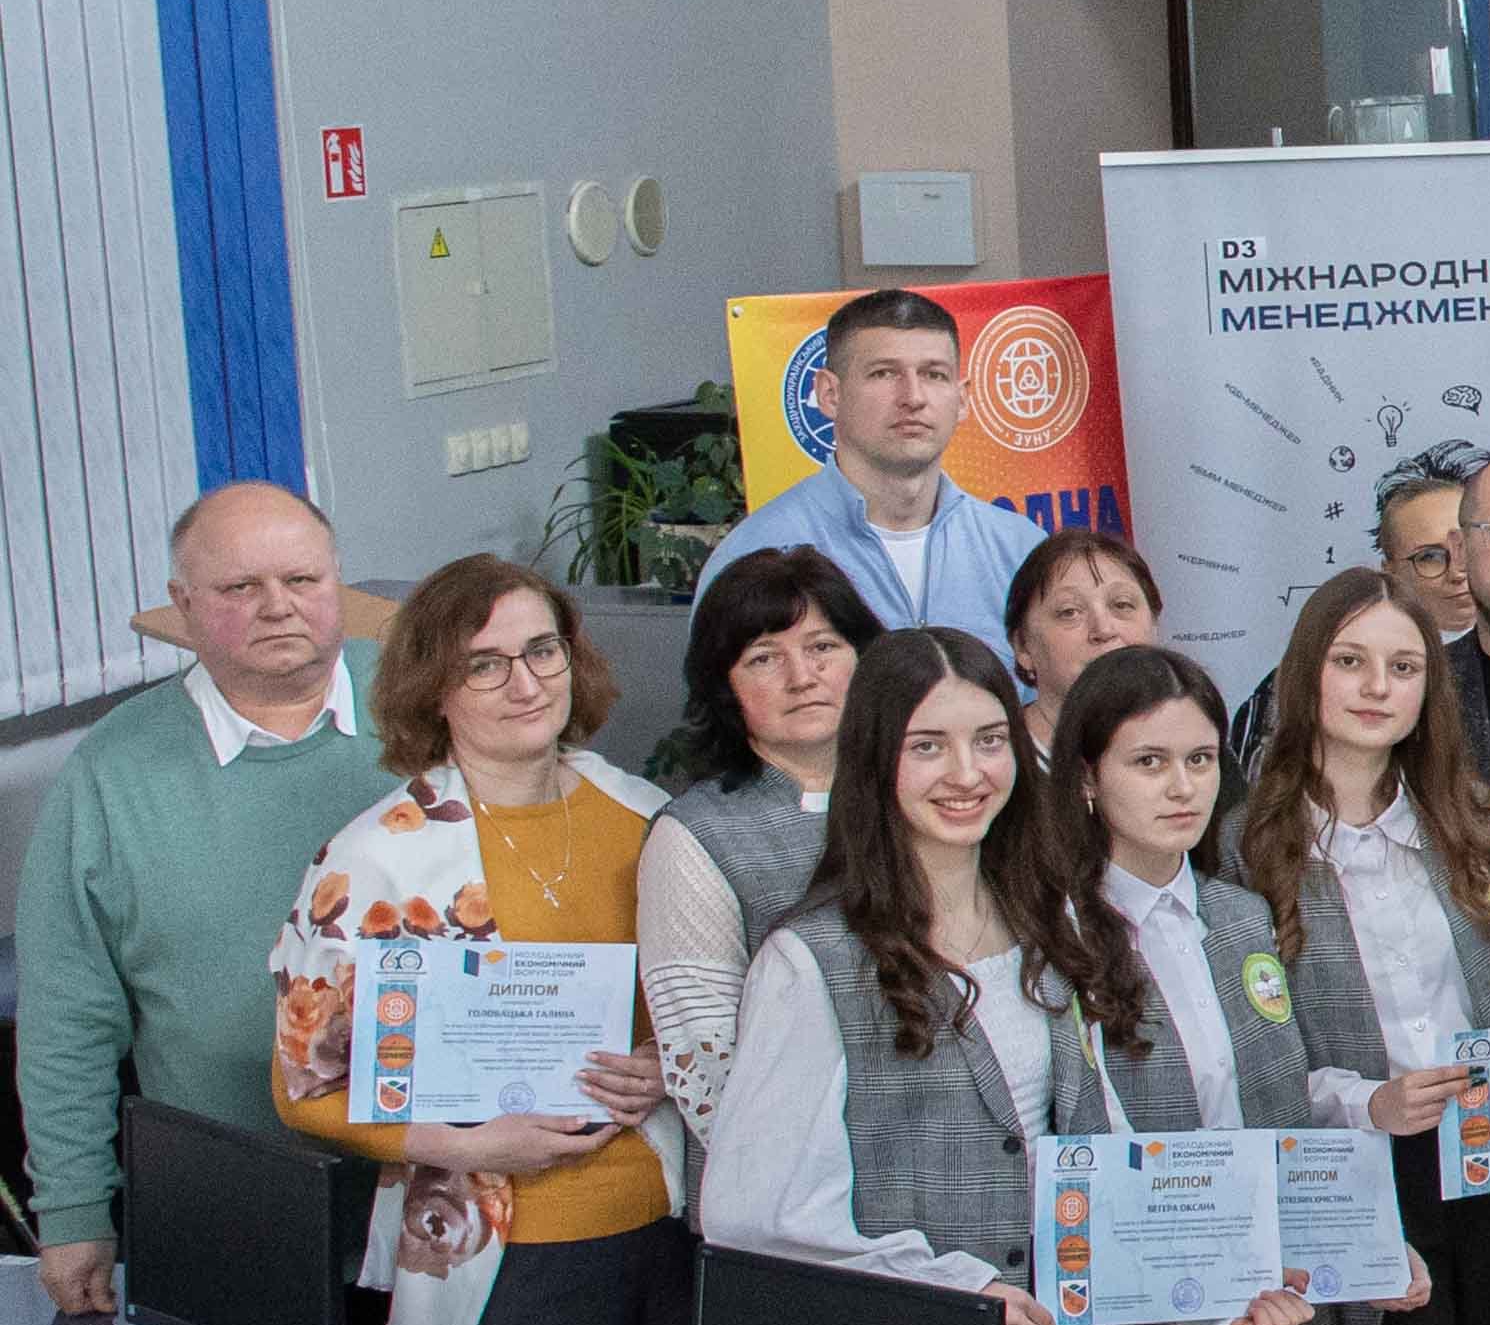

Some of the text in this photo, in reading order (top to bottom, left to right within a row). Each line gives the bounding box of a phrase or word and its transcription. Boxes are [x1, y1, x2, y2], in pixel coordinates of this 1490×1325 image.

[1222, 240, 1257, 259] D3
[1013, 431, 1052, 446] ЗУНУ
[514, 959, 586, 969] ЕКОНОМІЧНИЙ
[488, 984, 559, 997] ДИПЛОМ
[1172, 1148, 1234, 1158] ЕКОНОМІЧНИЙ
[1287, 1170, 1339, 1184] ДИПЛОМ
[1151, 1176, 1213, 1192] ДИПЛОМ
[1180, 1202, 1216, 1213] ОКСАНА
